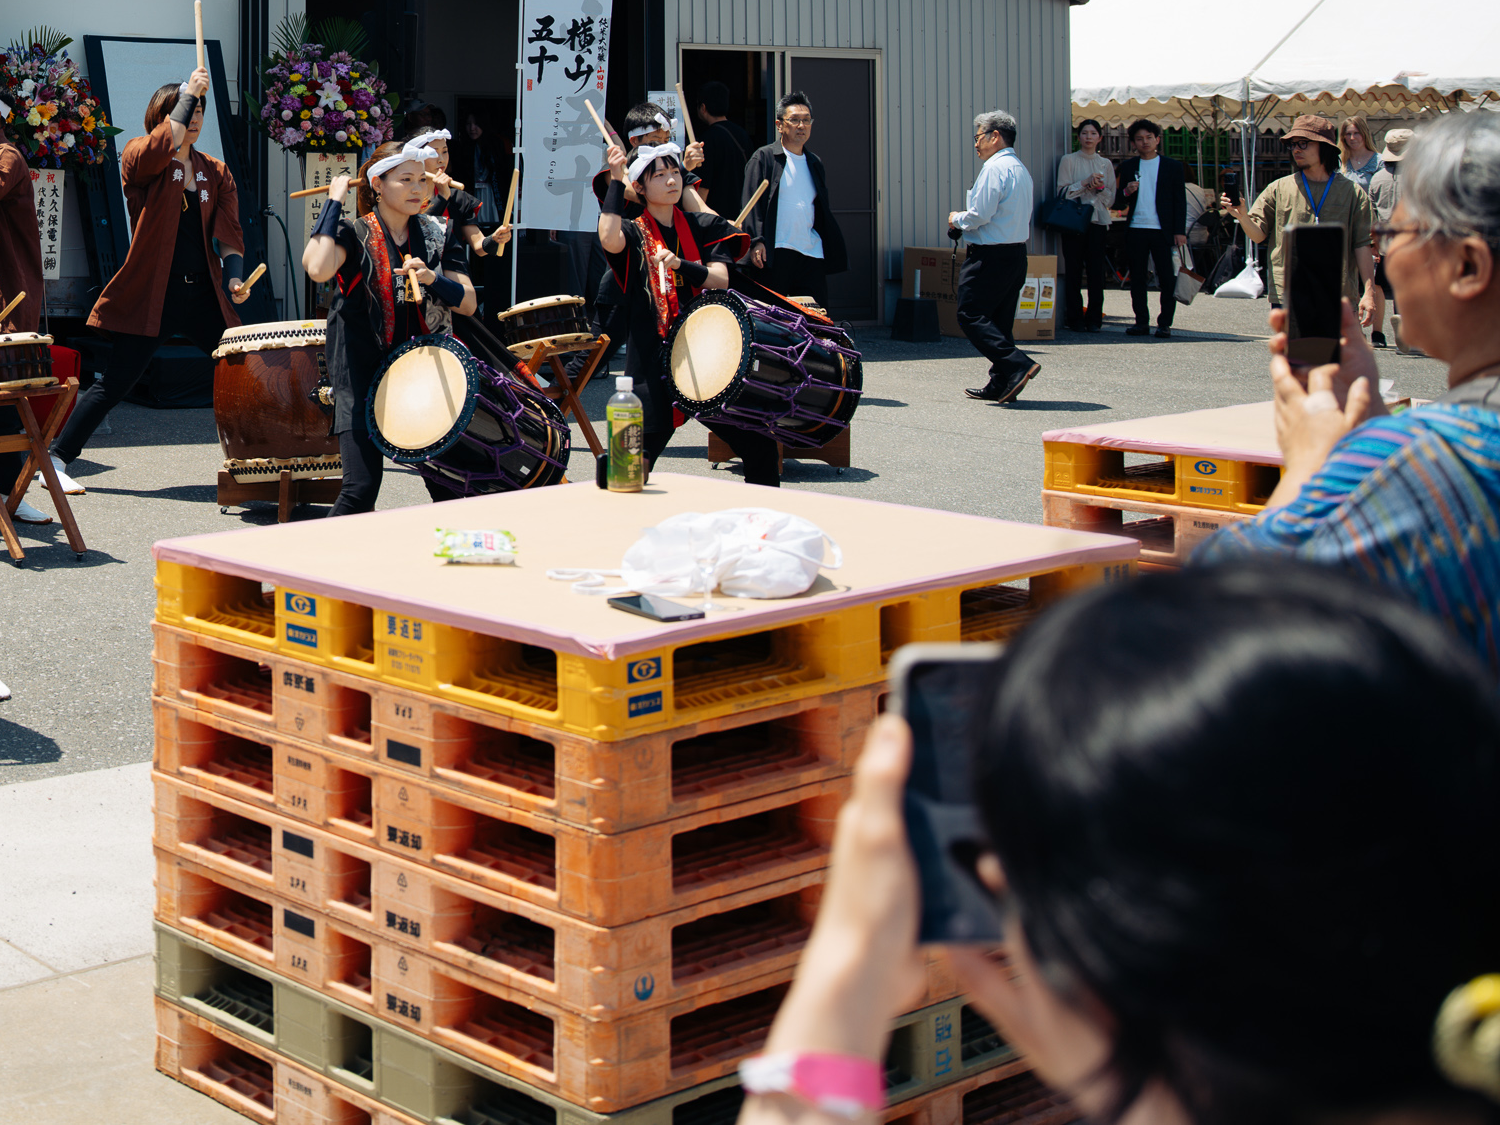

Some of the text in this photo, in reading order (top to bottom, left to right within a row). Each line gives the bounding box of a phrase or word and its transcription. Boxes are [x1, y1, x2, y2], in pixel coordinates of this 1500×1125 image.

[528, 15, 566, 85] 五十
[563, 16, 596, 95] 横山
[548, 95, 563, 188] Yokoyama Goju
[385, 910, 420, 938] 要返却
[386, 992, 421, 1023] 要返却
